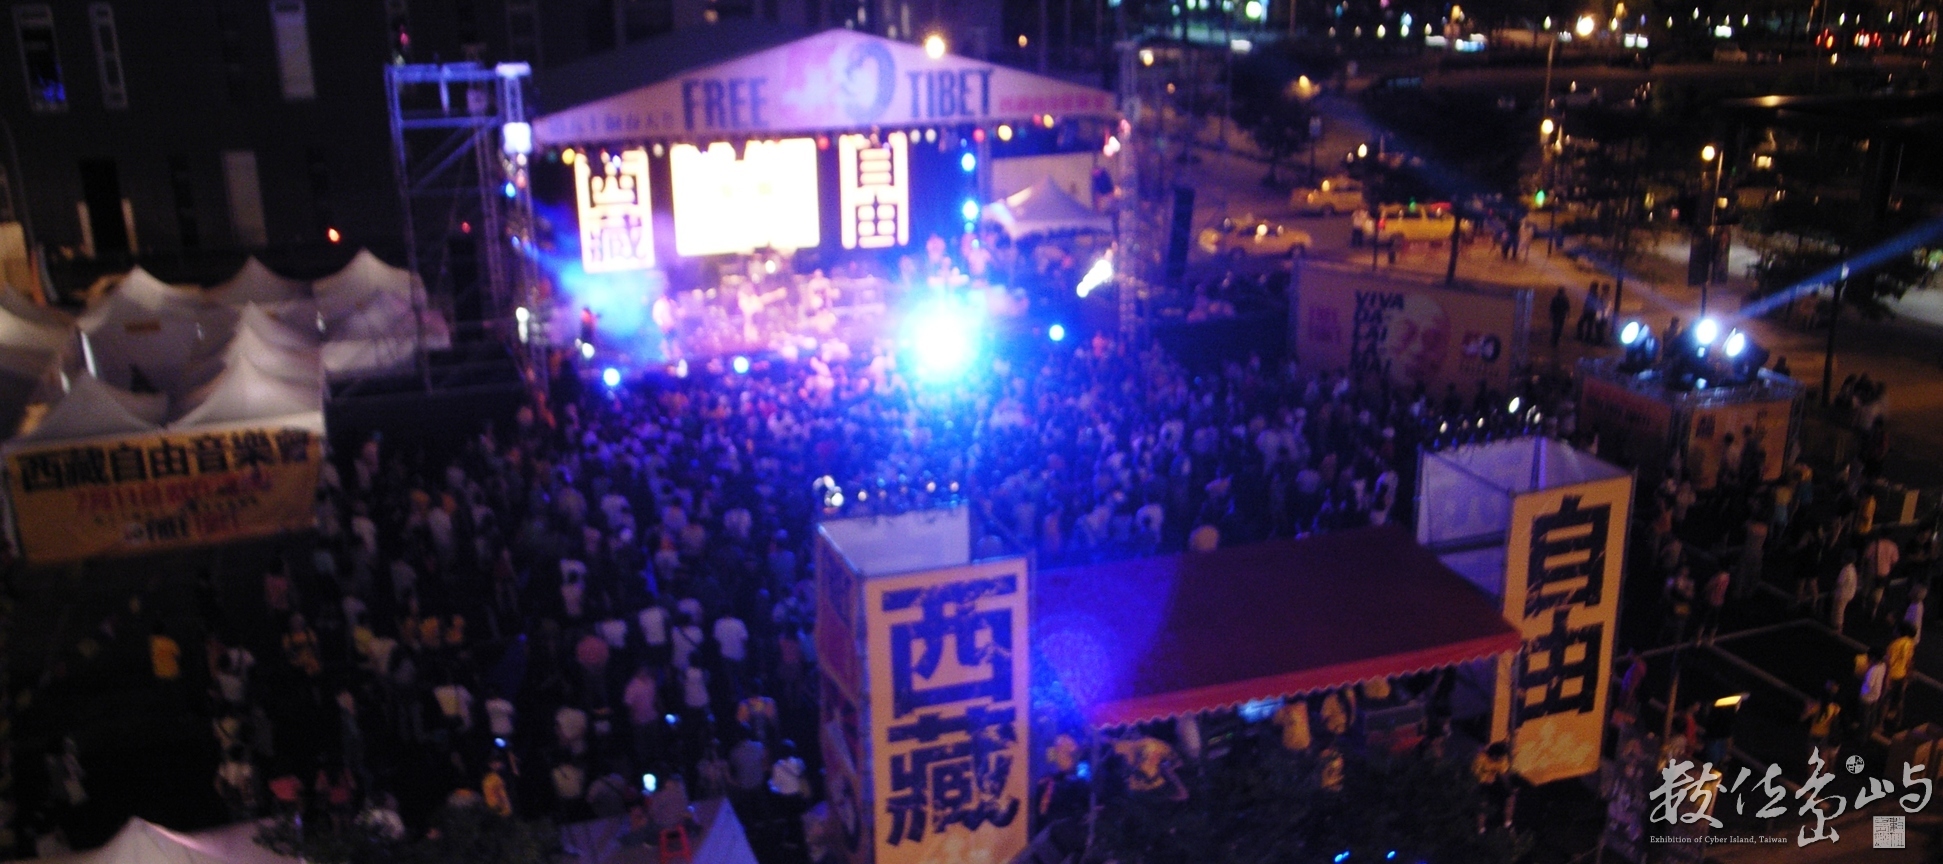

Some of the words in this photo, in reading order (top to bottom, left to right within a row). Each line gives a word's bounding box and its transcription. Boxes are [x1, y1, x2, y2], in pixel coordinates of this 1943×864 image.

[683, 77, 769, 131] FREE
[905, 67, 994, 119] TIBET
[882, 574, 1019, 846] 西藏
[1515, 494, 1612, 730] 自由
